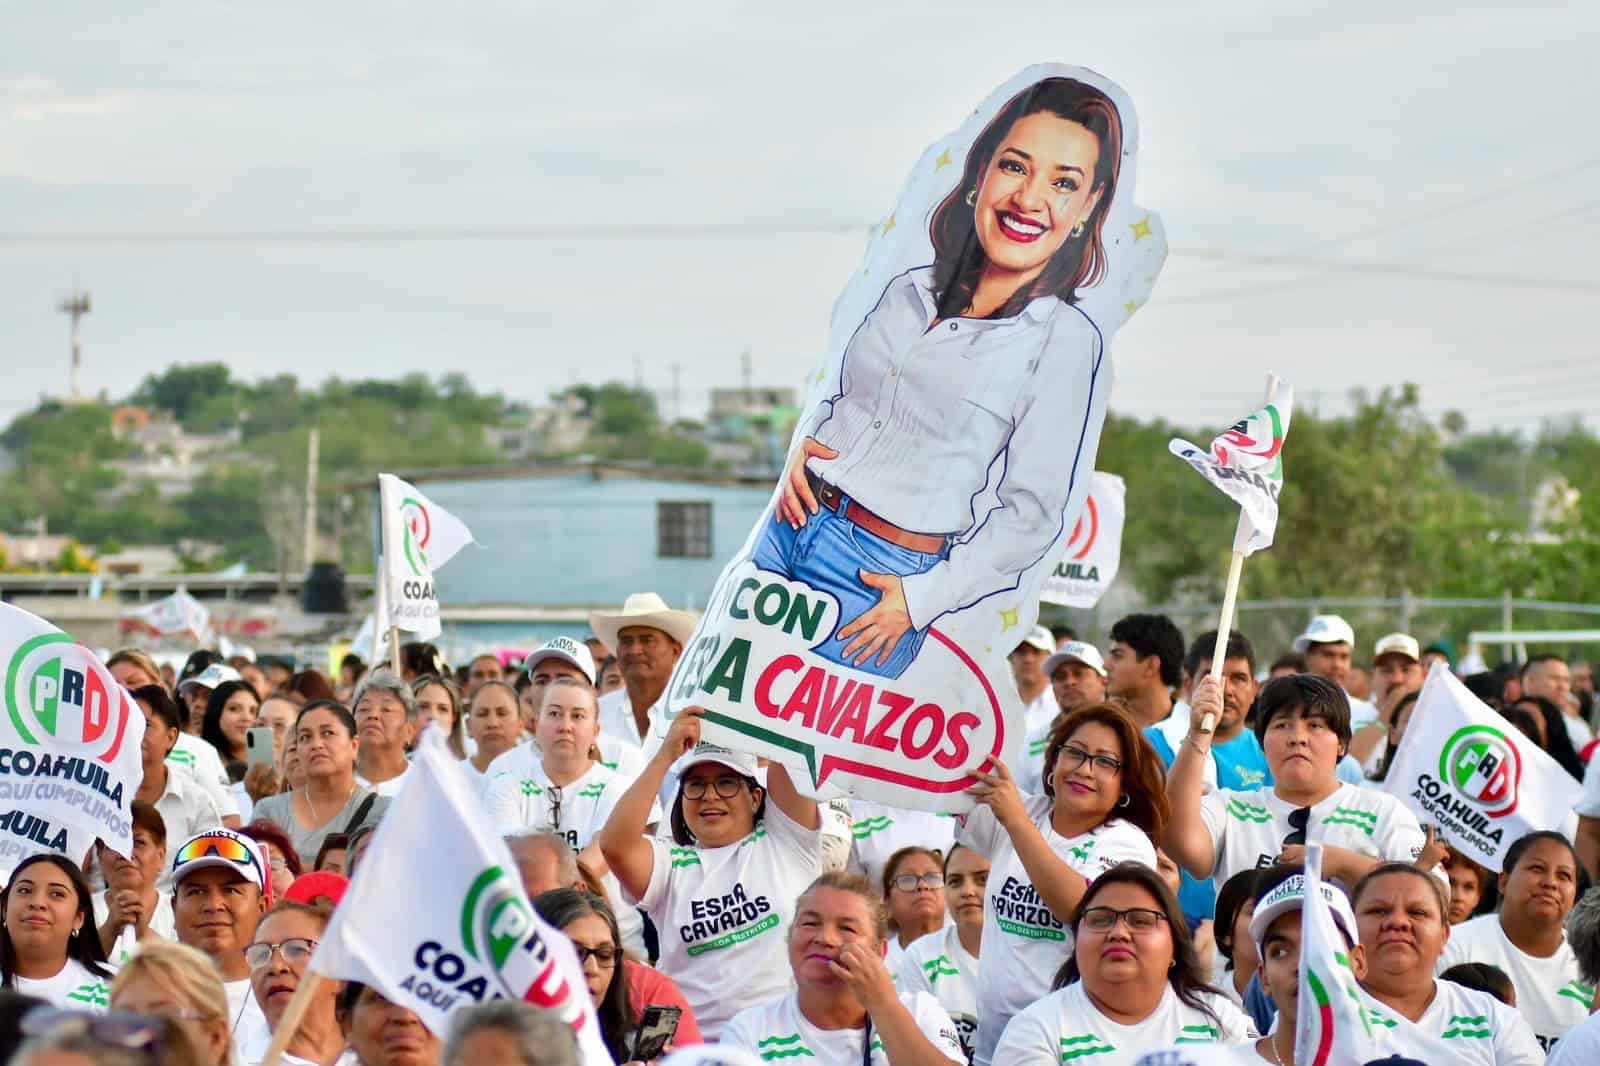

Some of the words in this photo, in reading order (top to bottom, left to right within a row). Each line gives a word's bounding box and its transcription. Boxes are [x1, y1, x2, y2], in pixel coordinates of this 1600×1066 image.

[729, 577, 828, 642] CON
[33, 664, 104, 731] PRI
[754, 654, 981, 770] CAVAZOS
[0, 748, 124, 810] COAHUILA
[1417, 773, 1504, 845] COAHUILA
[34, 783, 131, 839] CUMPLIMOS
[1434, 810, 1497, 857] CUMPLIMOS
[679, 895, 771, 943] CAVAZOS
[399, 974, 457, 1014] AQUÍ
[415, 940, 503, 1001] COA
